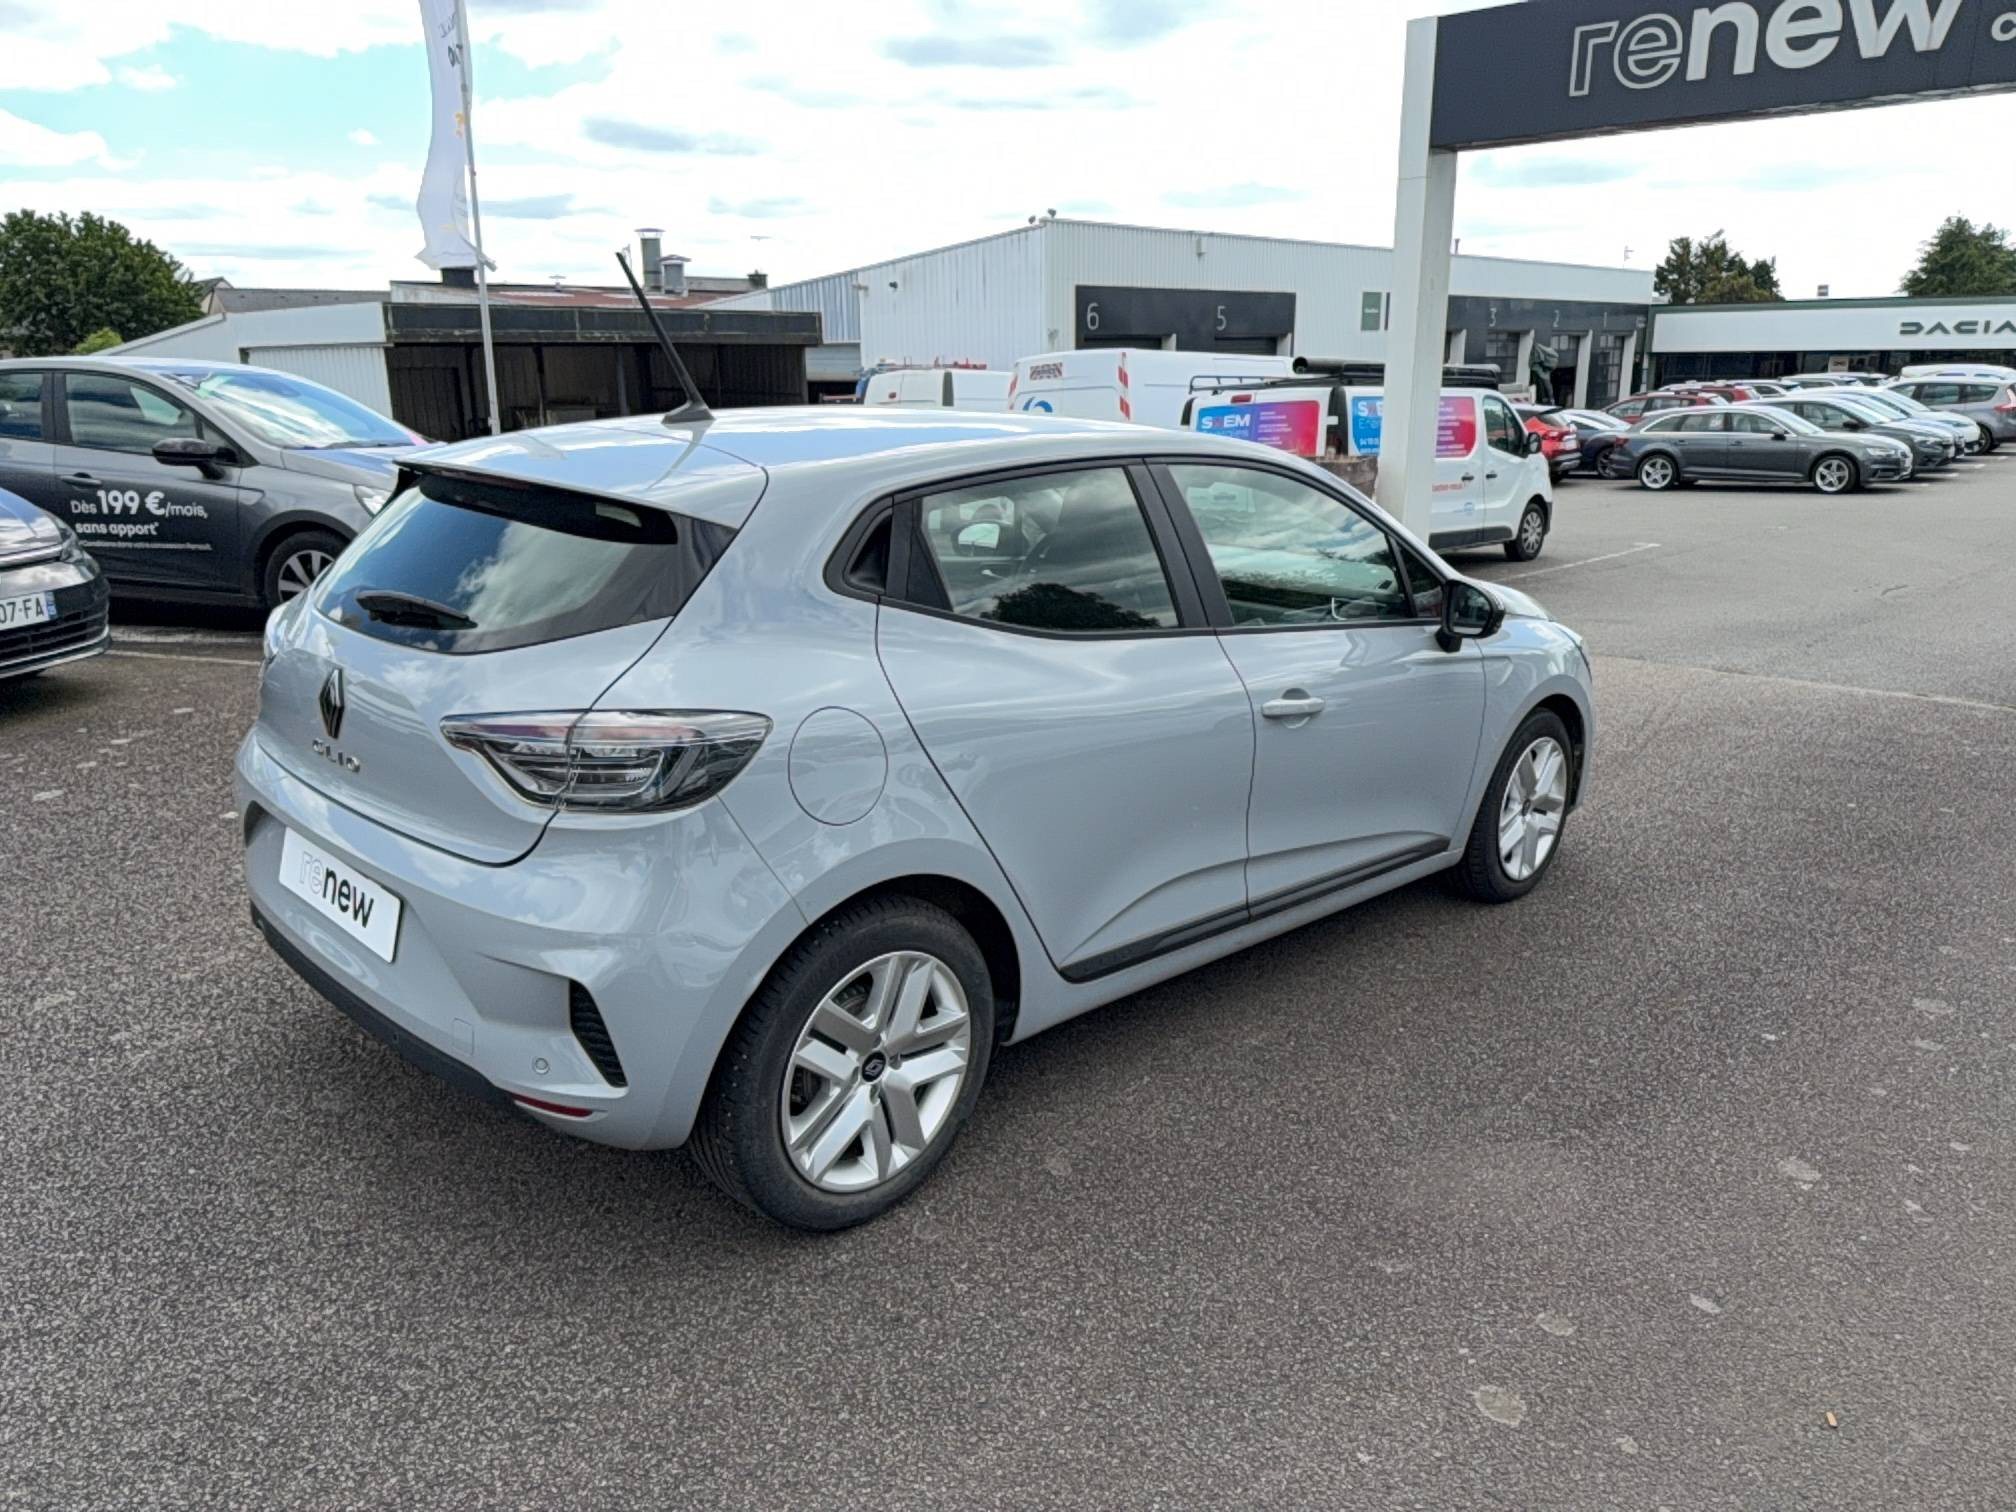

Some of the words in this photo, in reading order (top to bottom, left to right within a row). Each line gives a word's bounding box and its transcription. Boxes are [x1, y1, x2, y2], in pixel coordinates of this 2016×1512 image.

[1569, 0, 1963, 97] renew
[1086, 302, 1100, 331] 6
[1216, 305, 1227, 331] 5
[1488, 307, 1497, 328] 3
[1552, 309, 1560, 328] 2
[1899, 319, 2016, 335] DACIA
[70, 500, 97, 514] Dès
[97, 489, 140, 515] 199
[144, 490, 165, 516] €
[76, 522, 107, 534] sans
[312, 737, 361, 773] CLIO
[299, 851, 374, 928] renew
